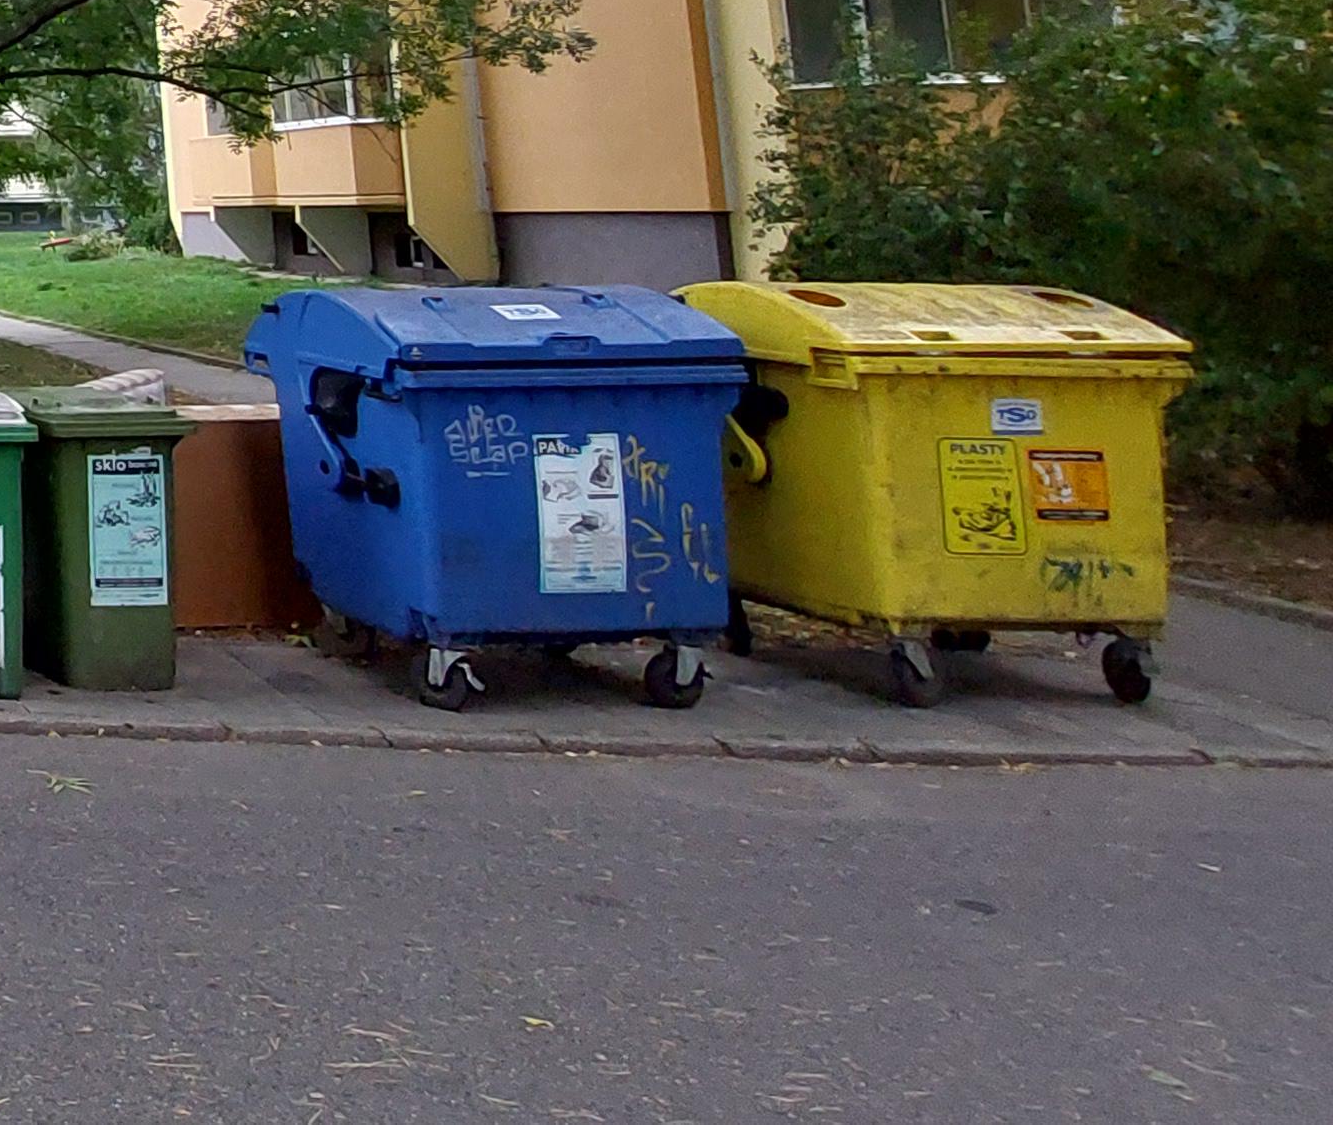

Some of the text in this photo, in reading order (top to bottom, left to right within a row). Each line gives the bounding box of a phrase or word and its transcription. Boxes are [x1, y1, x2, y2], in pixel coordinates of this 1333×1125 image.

[538, 440, 580, 454] PAP
[949, 443, 1006, 456] PLASTY
[95, 456, 126, 471] sklo
